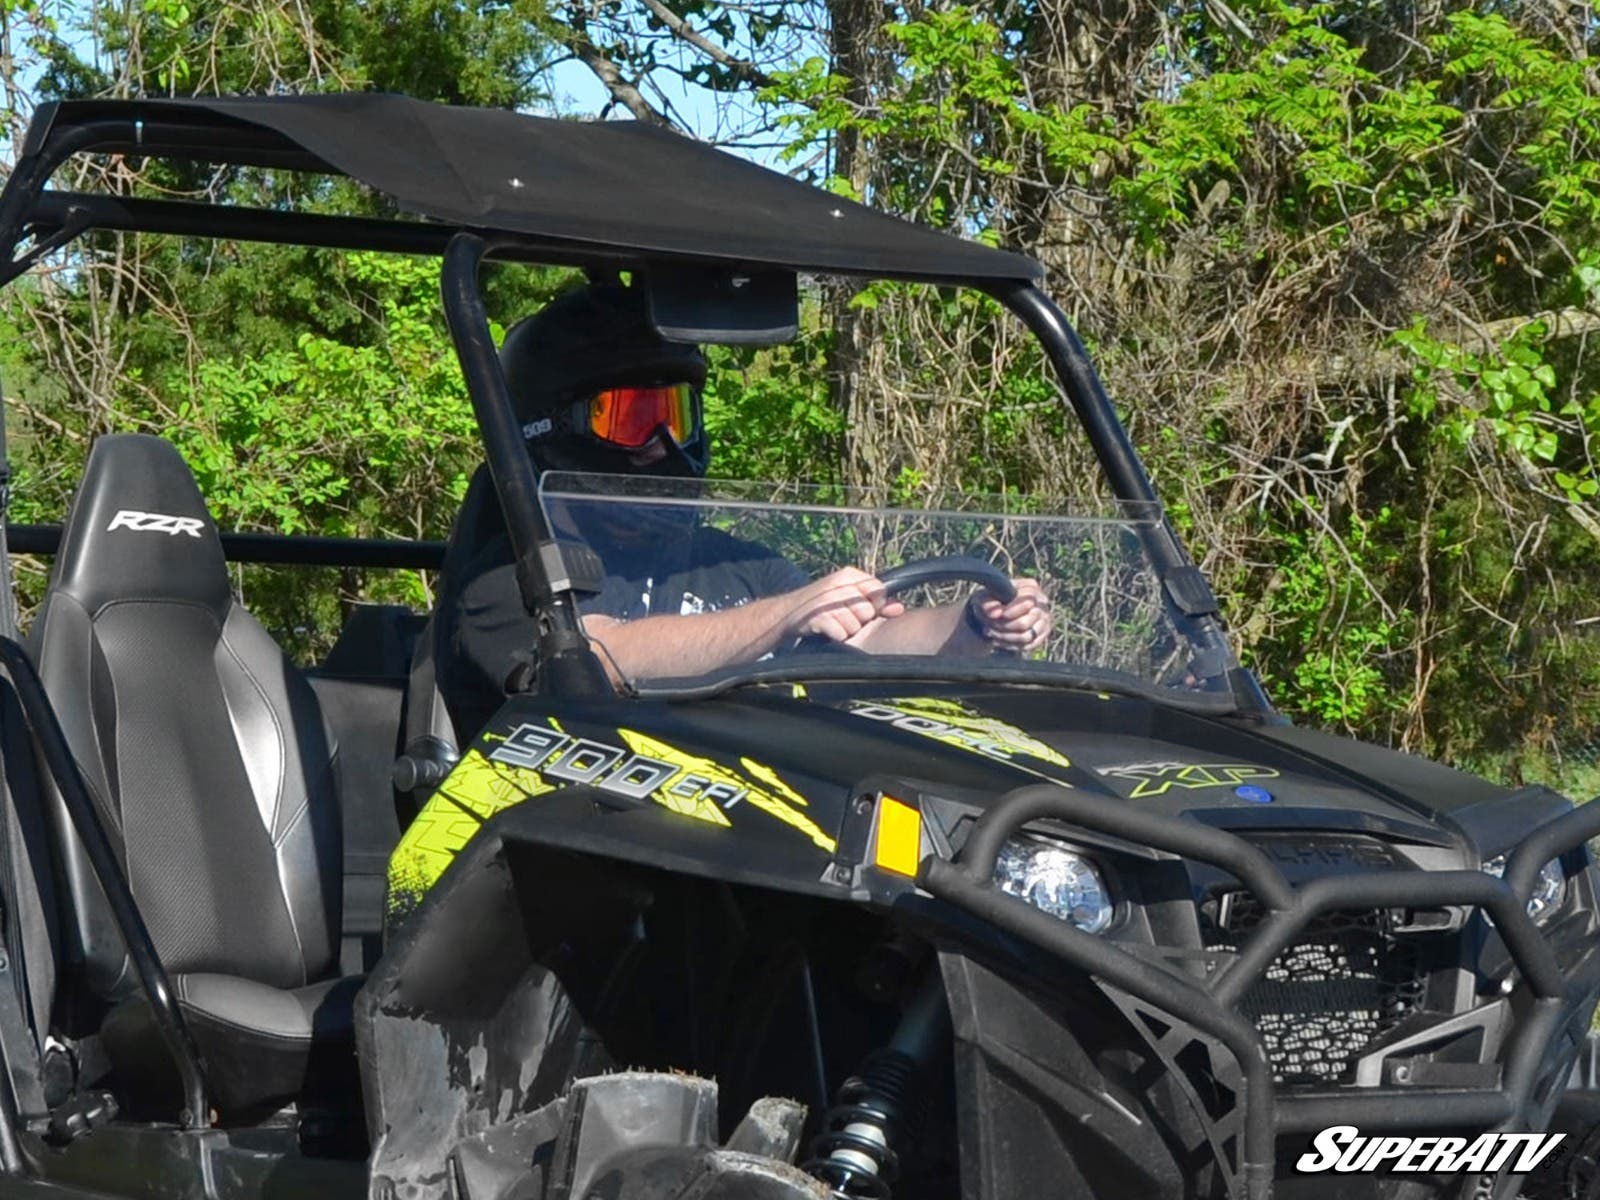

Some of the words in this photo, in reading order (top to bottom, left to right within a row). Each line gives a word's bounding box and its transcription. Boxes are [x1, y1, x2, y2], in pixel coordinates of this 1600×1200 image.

[106, 509, 206, 538] RZR
[490, 723, 682, 799] 900
[671, 774, 750, 809] EFI
[1104, 763, 1280, 799] XP
